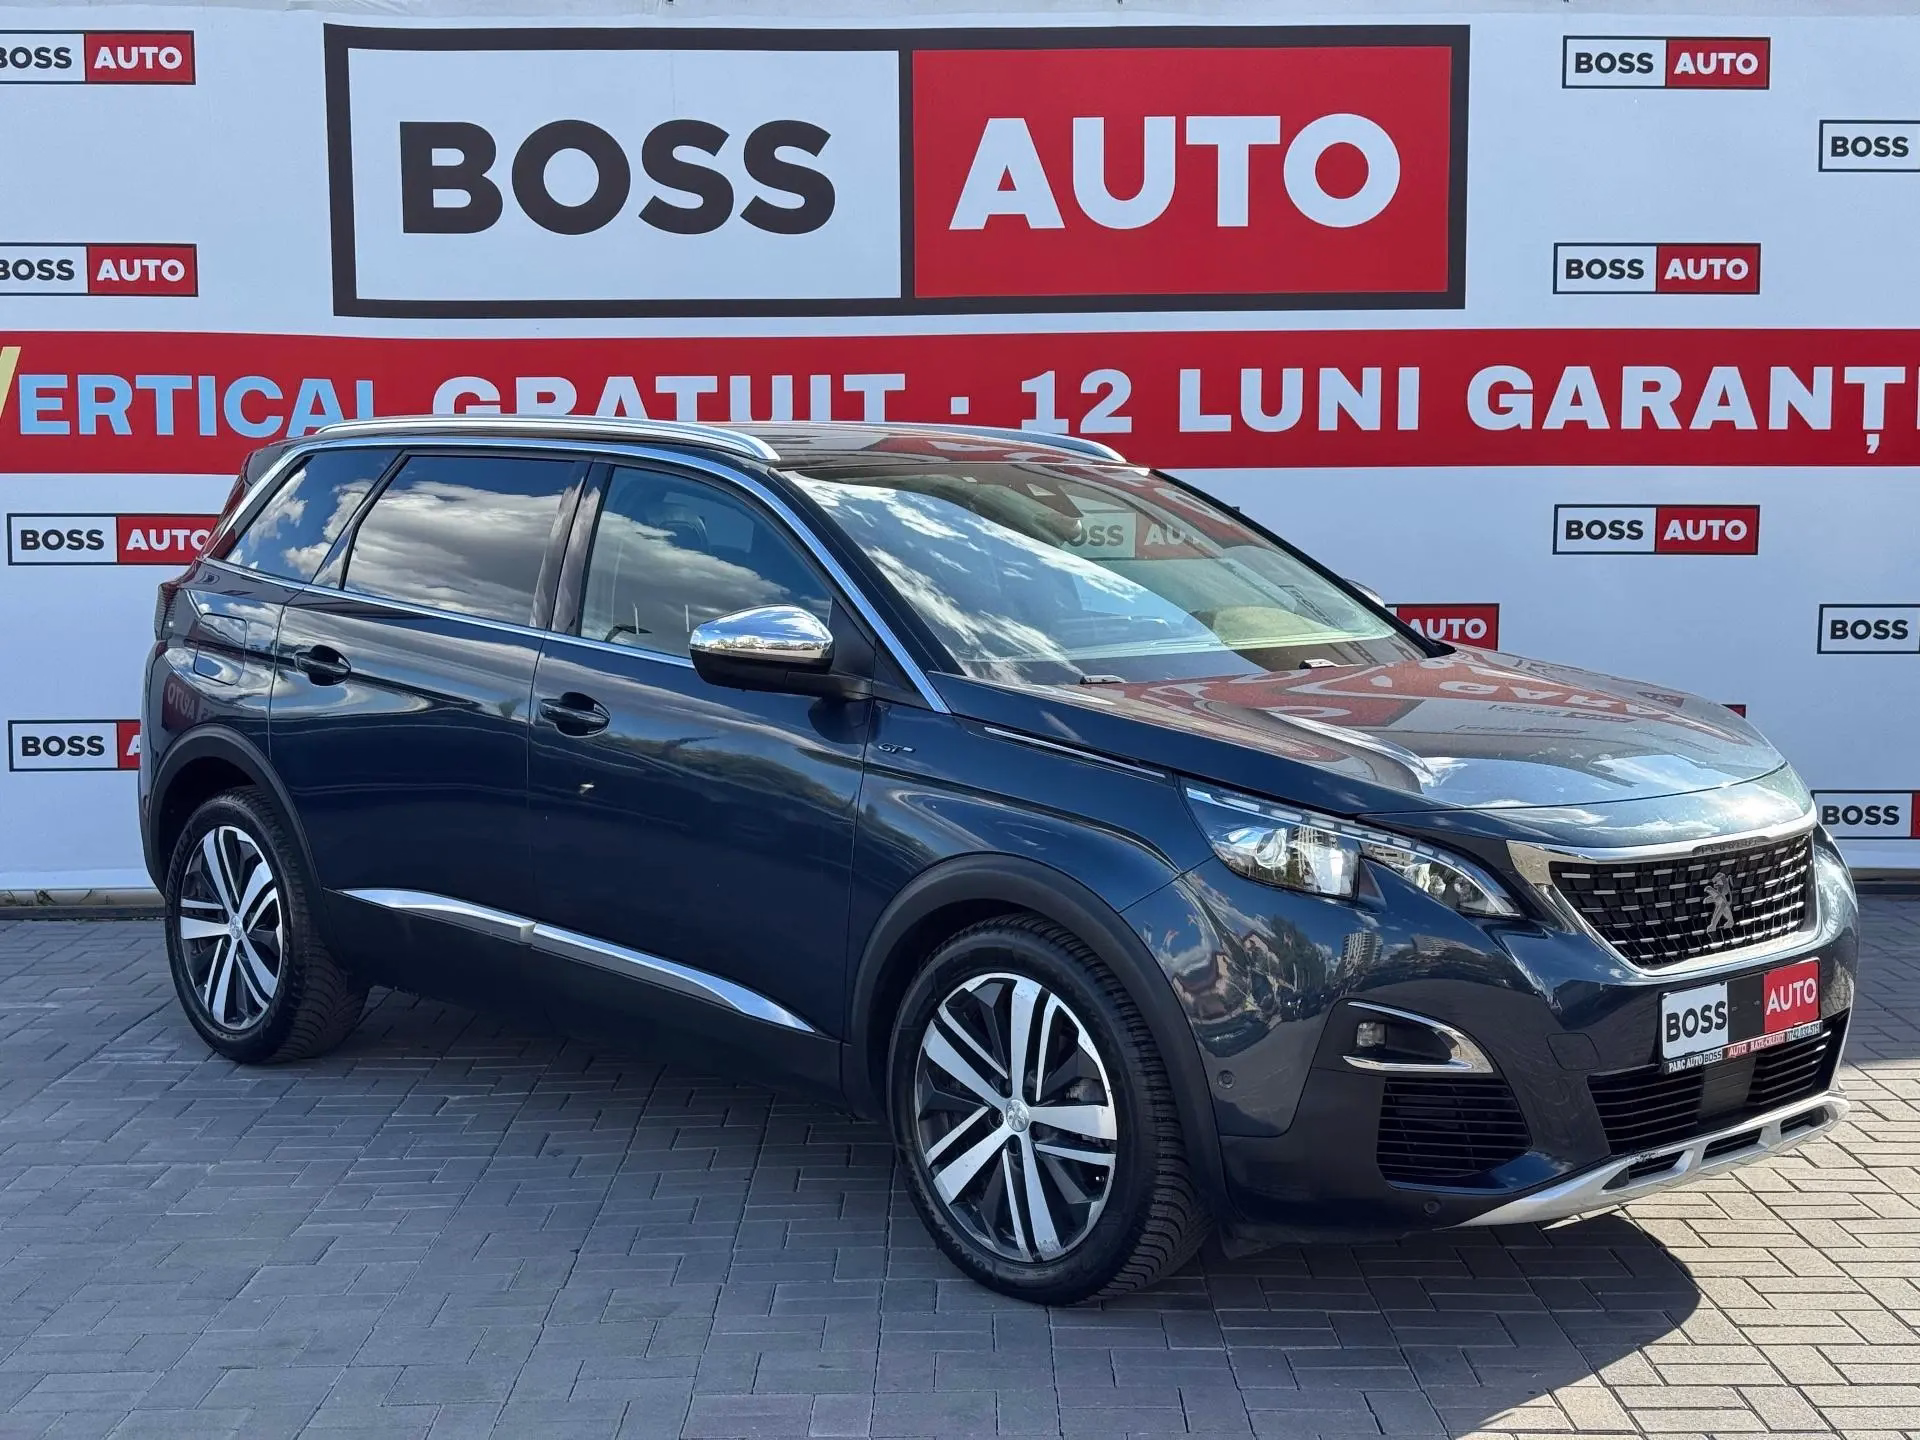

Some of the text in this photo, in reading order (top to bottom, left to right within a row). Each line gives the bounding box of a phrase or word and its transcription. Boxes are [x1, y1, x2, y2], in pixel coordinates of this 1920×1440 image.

[94, 46, 183, 70] AUTO
[1574, 51, 1759, 75] BOSS AUTO
[1830, 136, 1909, 158] BOSS
[400, 113, 1401, 236] BOSS AUTO
[97, 259, 186, 282] AUTO
[1565, 258, 1749, 281] BOSS AUTO
[0, 346, 1920, 454] ERTICA GRATUIT 12 LUNI GARANȚ
[20, 528, 211, 552] BOSS AUTO
[1066, 524, 1124, 547] OSS
[1565, 519, 1748, 541] BOSS AUTO
[1830, 619, 1909, 641] BOSS
[21, 735, 105, 757] BOSS
[1821, 805, 1900, 826] BOSS
[1666, 978, 1817, 1043] BOSS AUTO
[1669, 1060, 1686, 1073] PARC
[1686, 1053, 1703, 1069] AUTO
[1705, 1050, 1722, 1063] BOSS
[1729, 1043, 1748, 1057] AUTO
